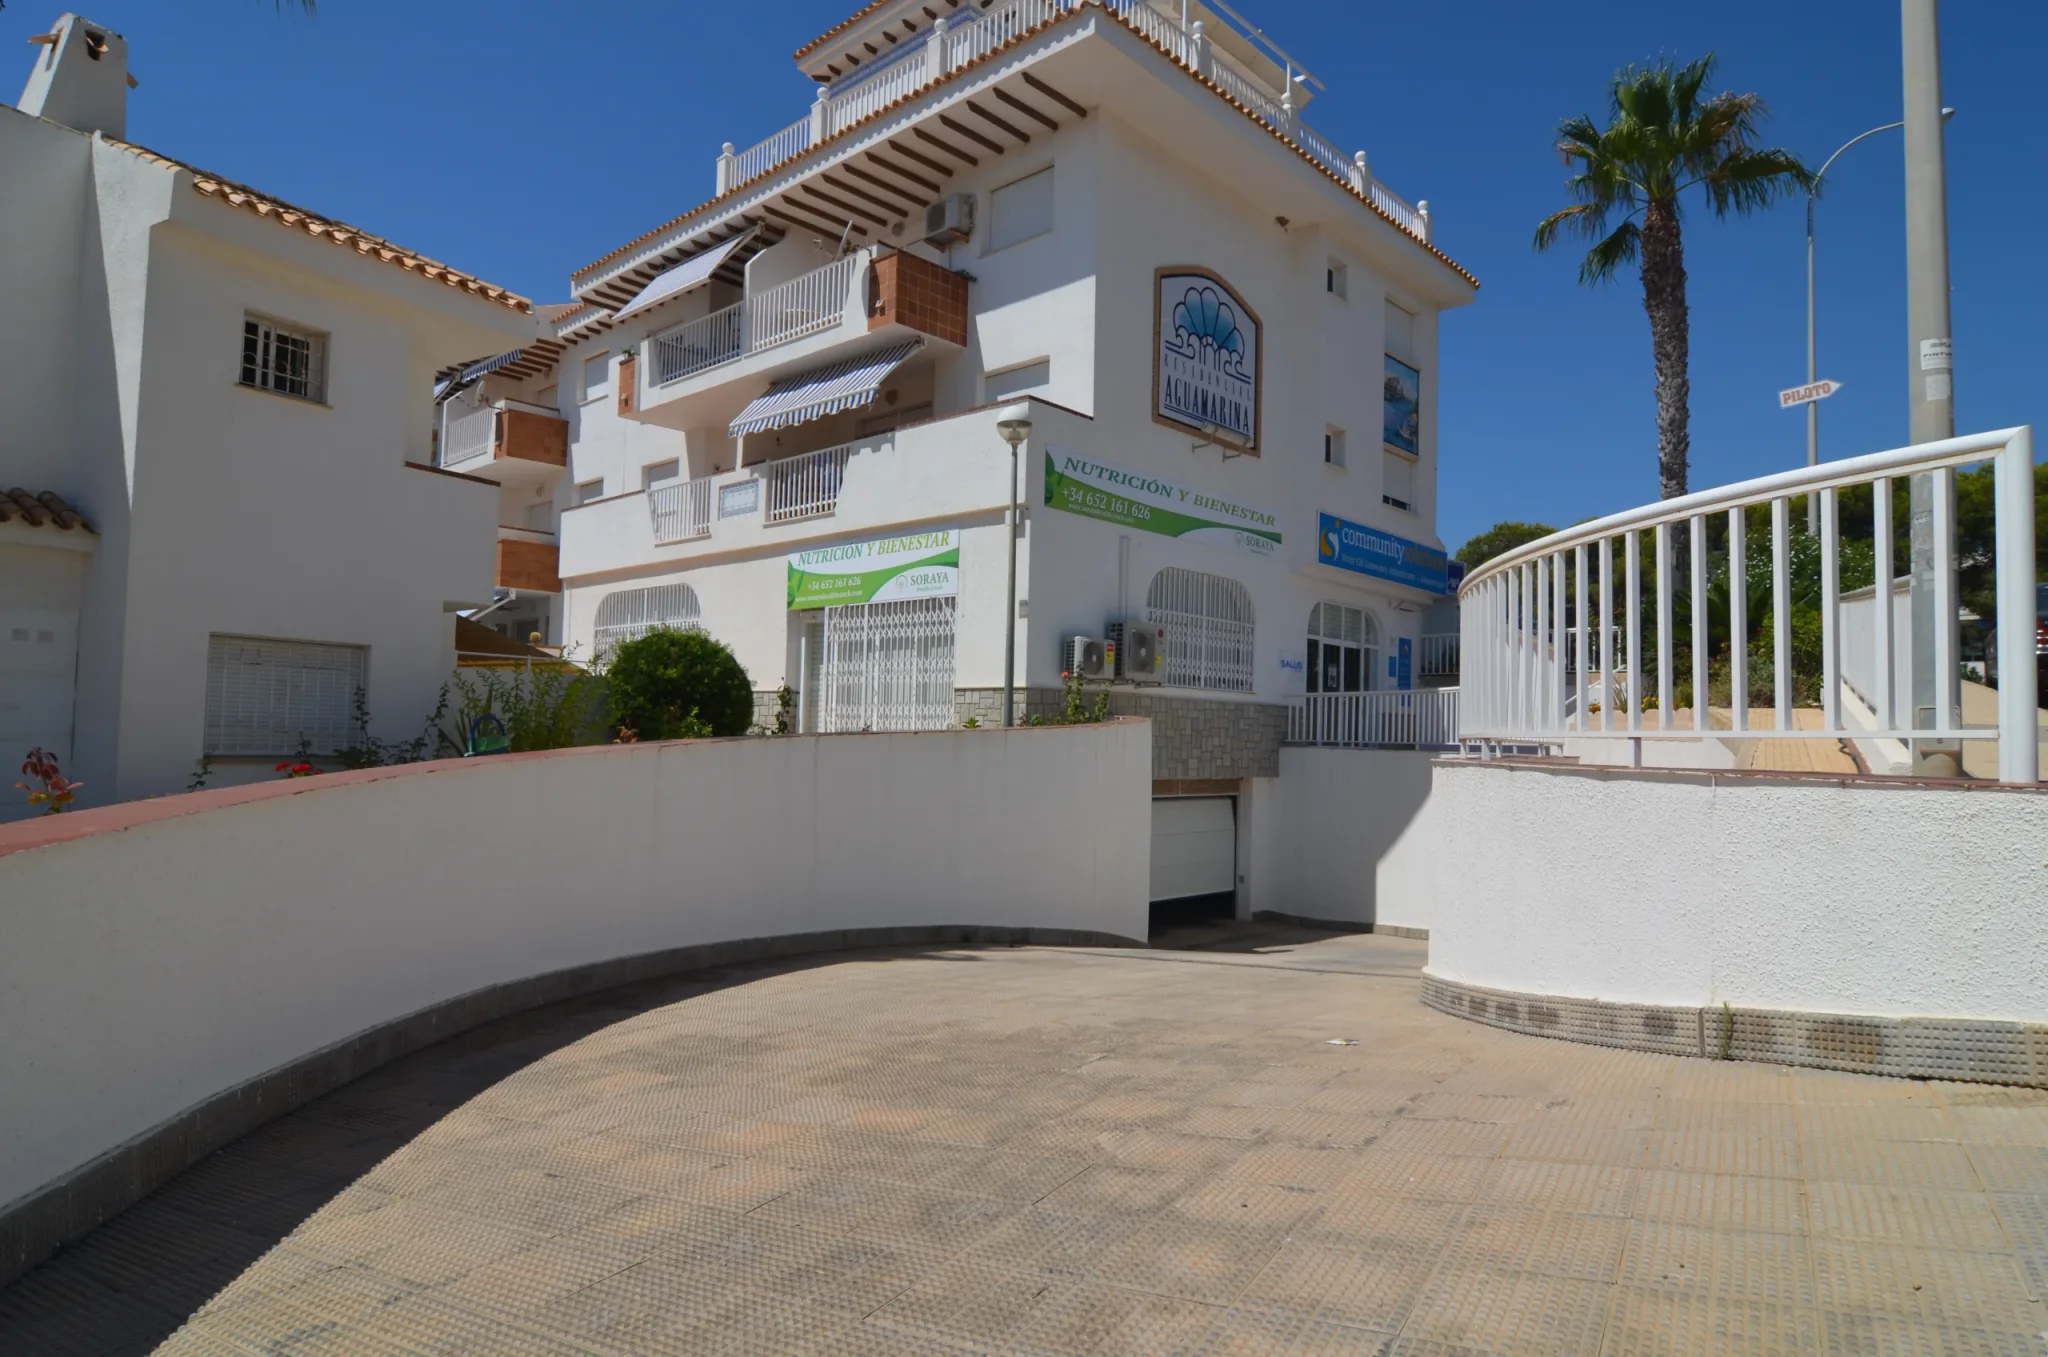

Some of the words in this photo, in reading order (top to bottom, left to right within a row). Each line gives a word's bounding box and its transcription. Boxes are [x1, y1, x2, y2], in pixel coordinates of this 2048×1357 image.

[1164, 353, 1251, 402] RESIDENCIAL
[1782, 382, 1831, 405] PILOTO
[1164, 374, 1249, 433] AGUAMARINA
[1062, 486, 1083, 502] +34
[1086, 491, 1107, 509] 652
[1110, 498, 1128, 513] 161
[1132, 503, 1151, 520] 626
[1064, 456, 1174, 498] NUTRICIÓN
[1178, 489, 1190, 501] Y
[1193, 494, 1276, 527] BIENESTAR
[798, 542, 864, 566] NUTRICIÓN
[866, 543, 876, 556] Y
[877, 531, 950, 555] BIENESTAR
[1246, 532, 1275, 551] SORAYA
[821, 579, 833, 590] 652
[835, 577, 847, 588] 161
[848, 576, 861, 587] 626
[910, 572, 949, 586] SORAYA
